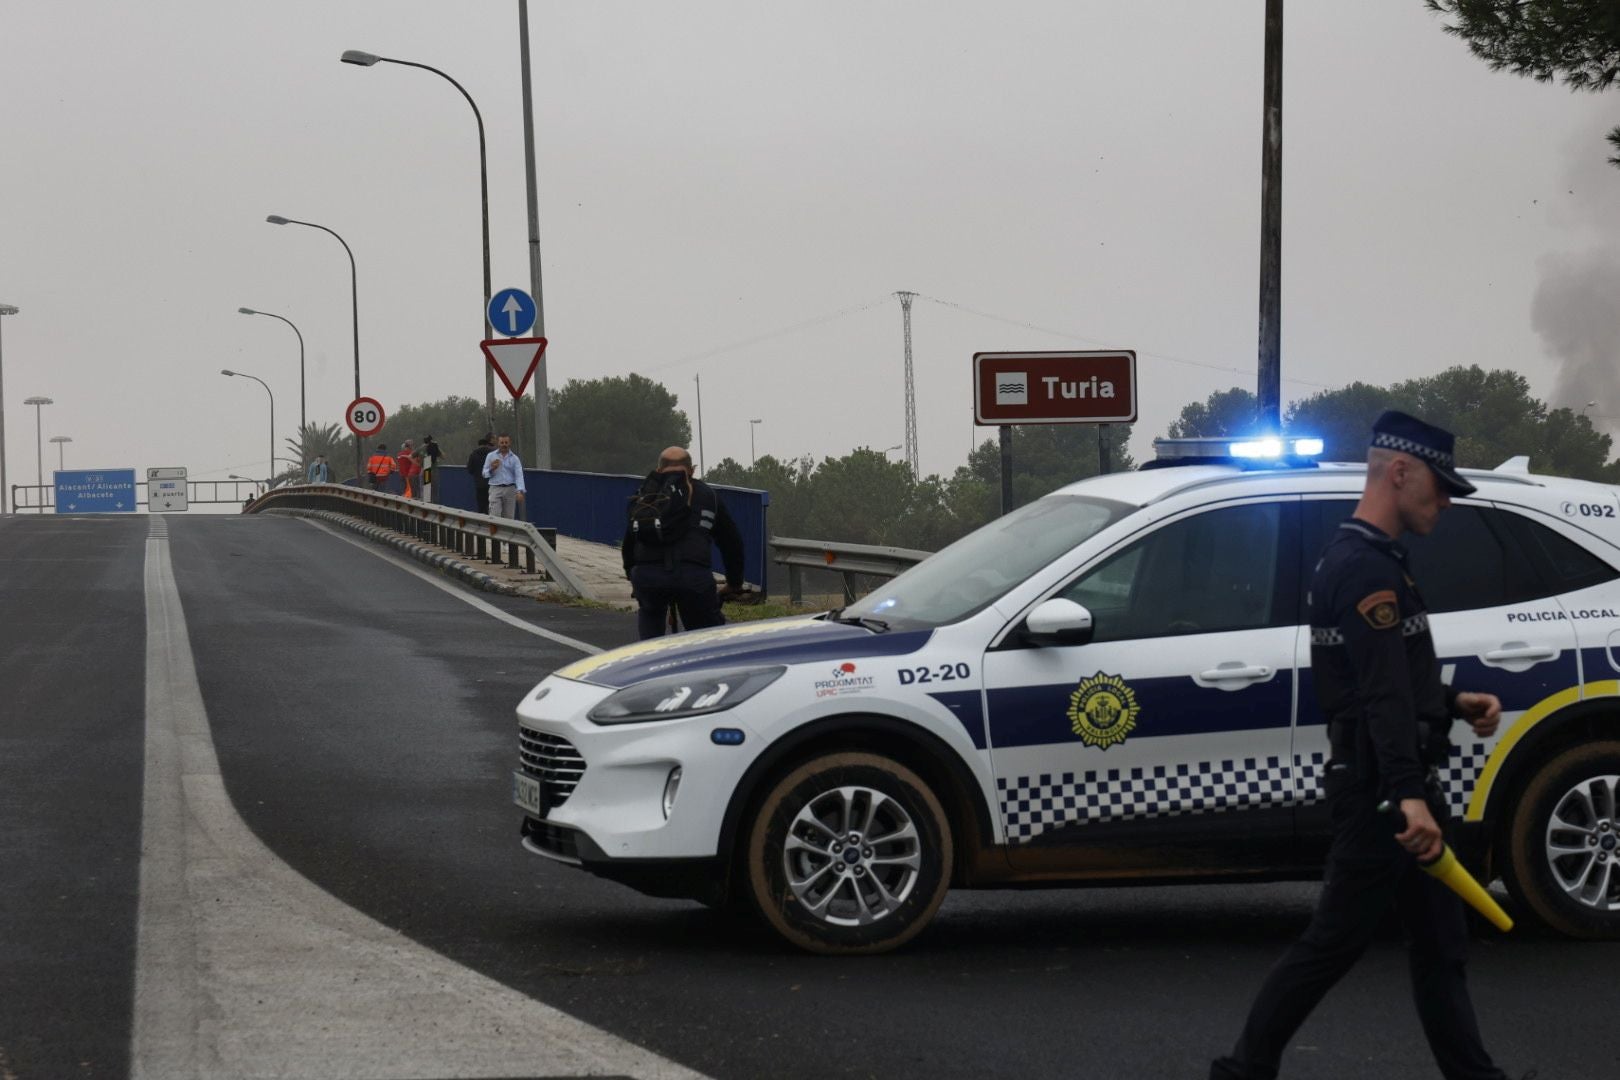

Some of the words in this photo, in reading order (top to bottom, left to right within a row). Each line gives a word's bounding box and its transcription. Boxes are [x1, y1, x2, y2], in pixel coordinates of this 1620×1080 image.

[1042, 375, 1115, 399] Turia
[354, 410, 377, 423] 80
[78, 491, 114, 499] Albacete
[1579, 503, 1616, 518] 092
[1507, 611, 1567, 622] POLICIA
[1571, 609, 1619, 619] LOCAL
[897, 662, 971, 685] D2-20
[815, 676, 873, 689] PROXIMITAT
